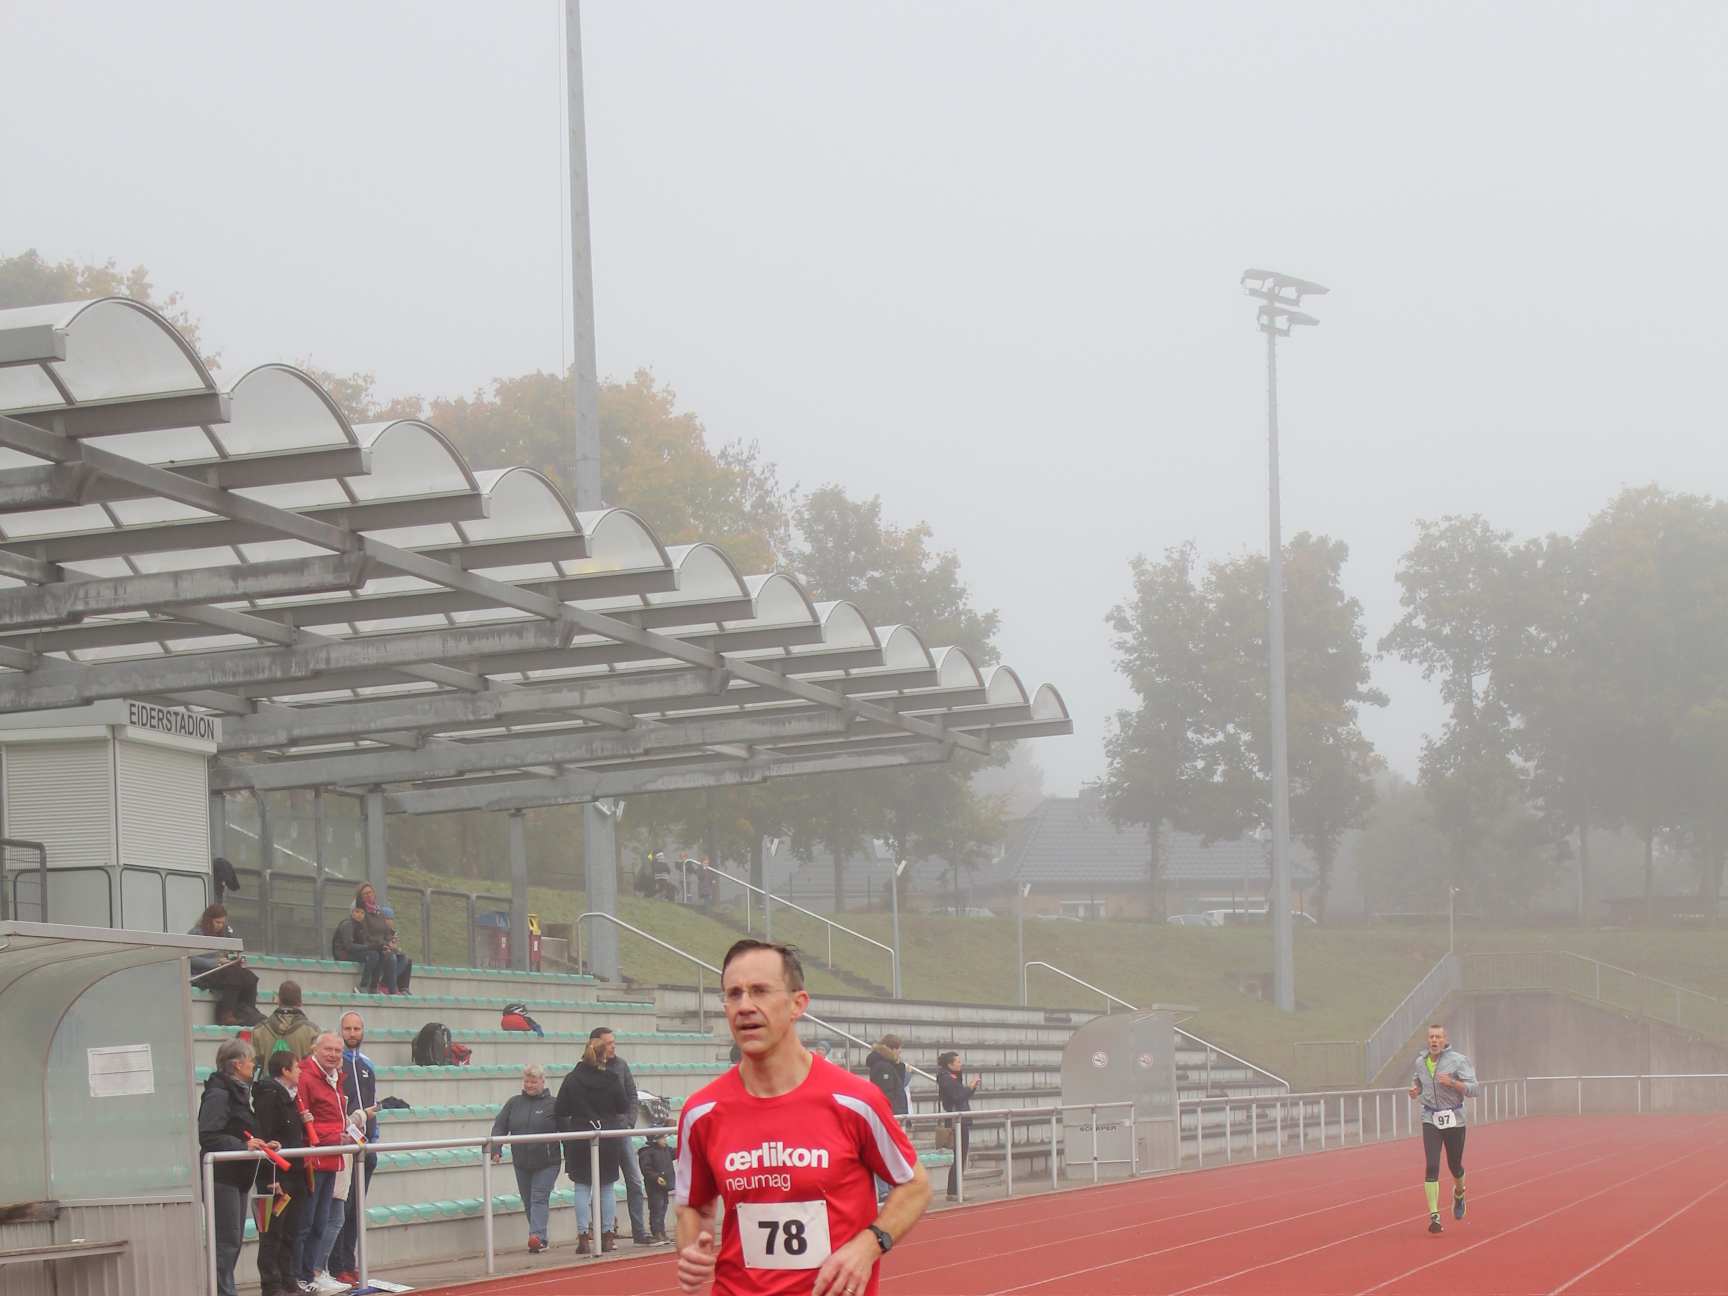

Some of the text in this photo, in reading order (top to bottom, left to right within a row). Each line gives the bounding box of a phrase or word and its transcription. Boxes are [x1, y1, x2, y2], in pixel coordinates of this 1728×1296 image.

[129, 703, 215, 740] EIDERSTADION
[1438, 1115, 1449, 1125] 97
[726, 1173, 791, 1192] neumag
[758, 1219, 808, 1256] 78
